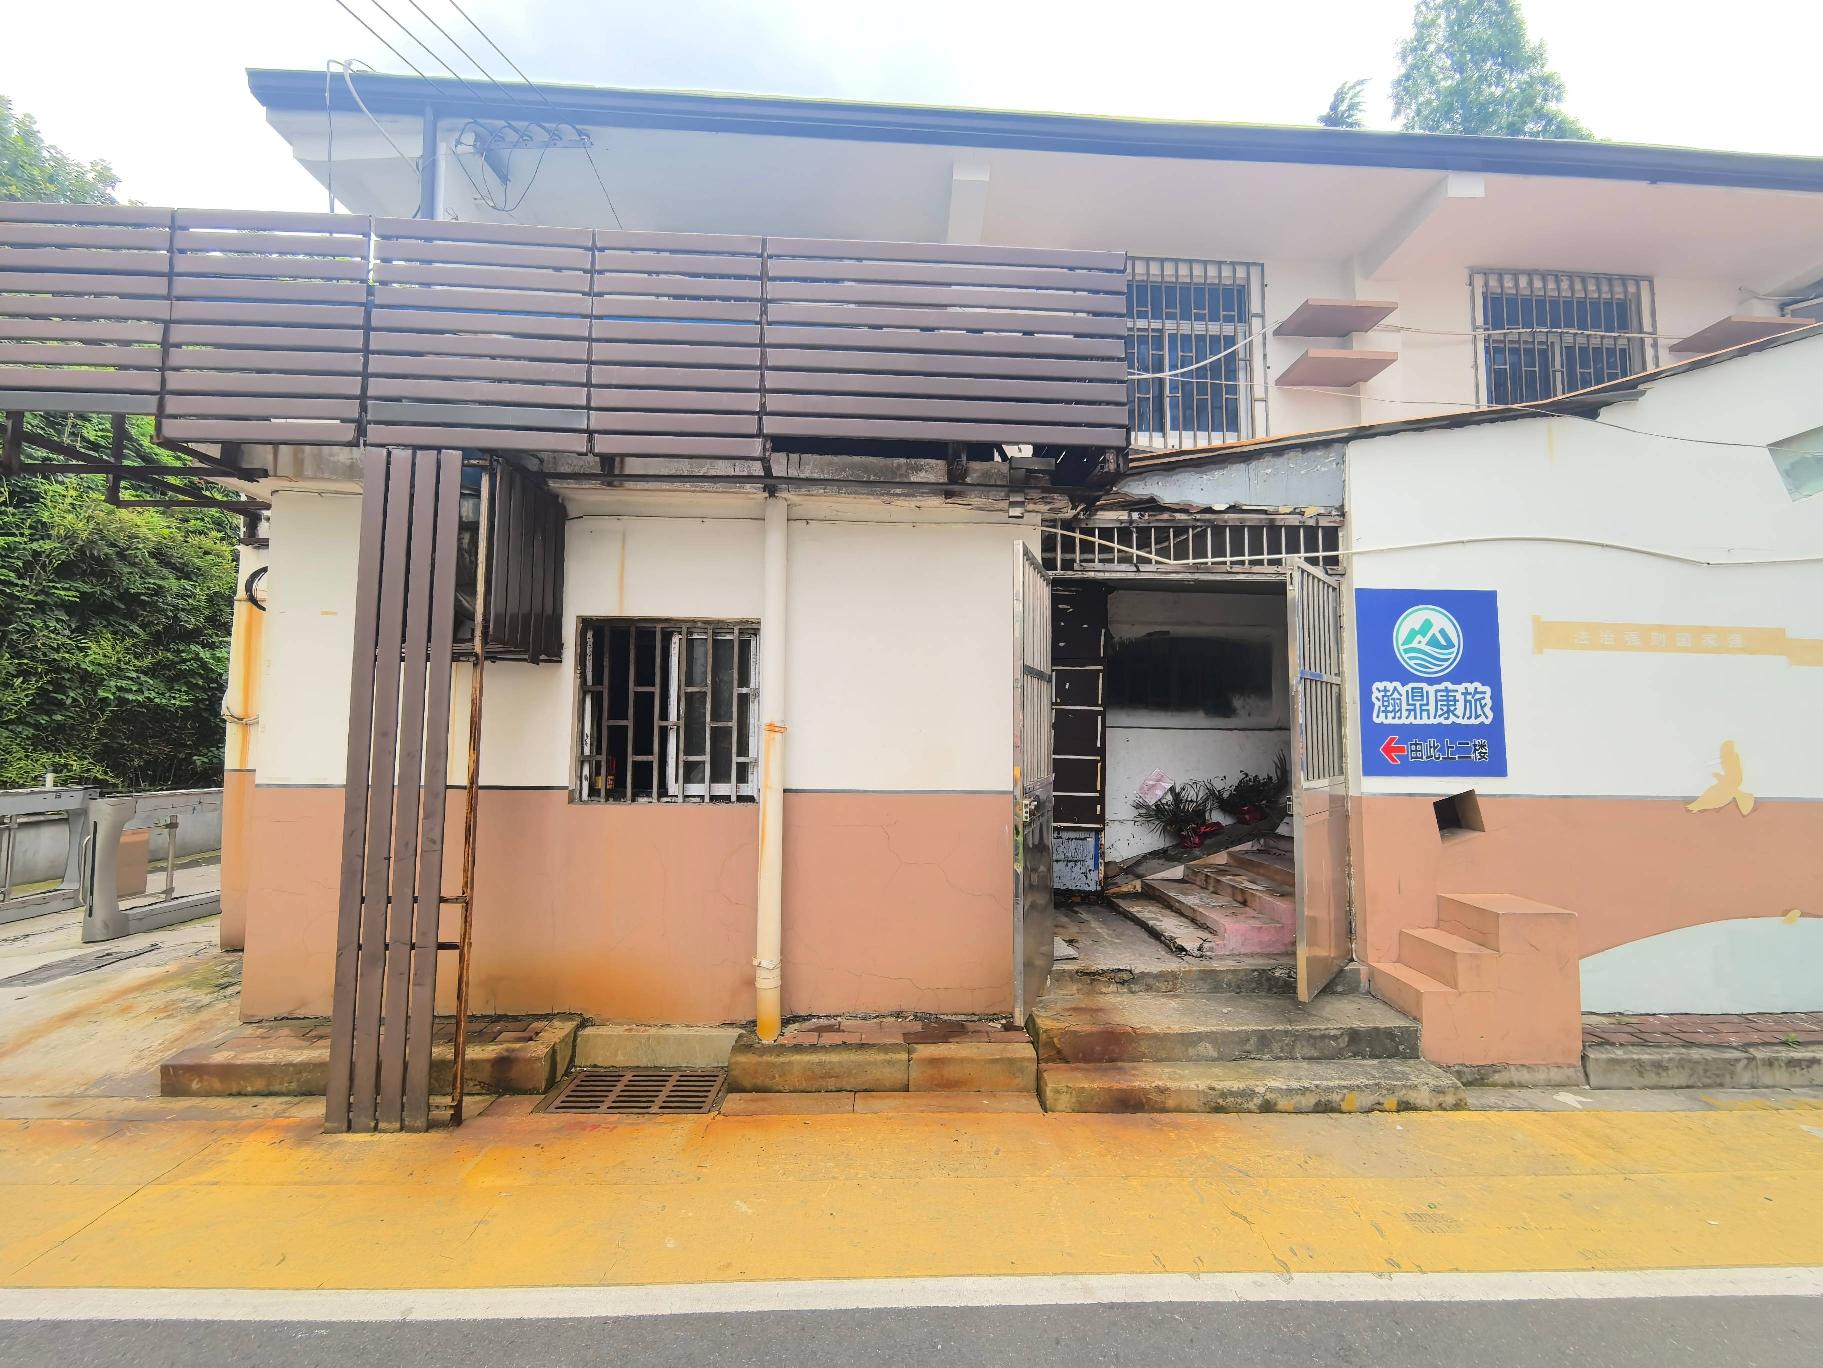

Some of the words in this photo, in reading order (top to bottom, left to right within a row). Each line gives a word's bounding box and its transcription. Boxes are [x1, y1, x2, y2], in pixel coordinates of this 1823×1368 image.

[1374, 684, 1490, 722] 瀚鼎康旅
[1408, 739, 1489, 762] 由此上二楼
